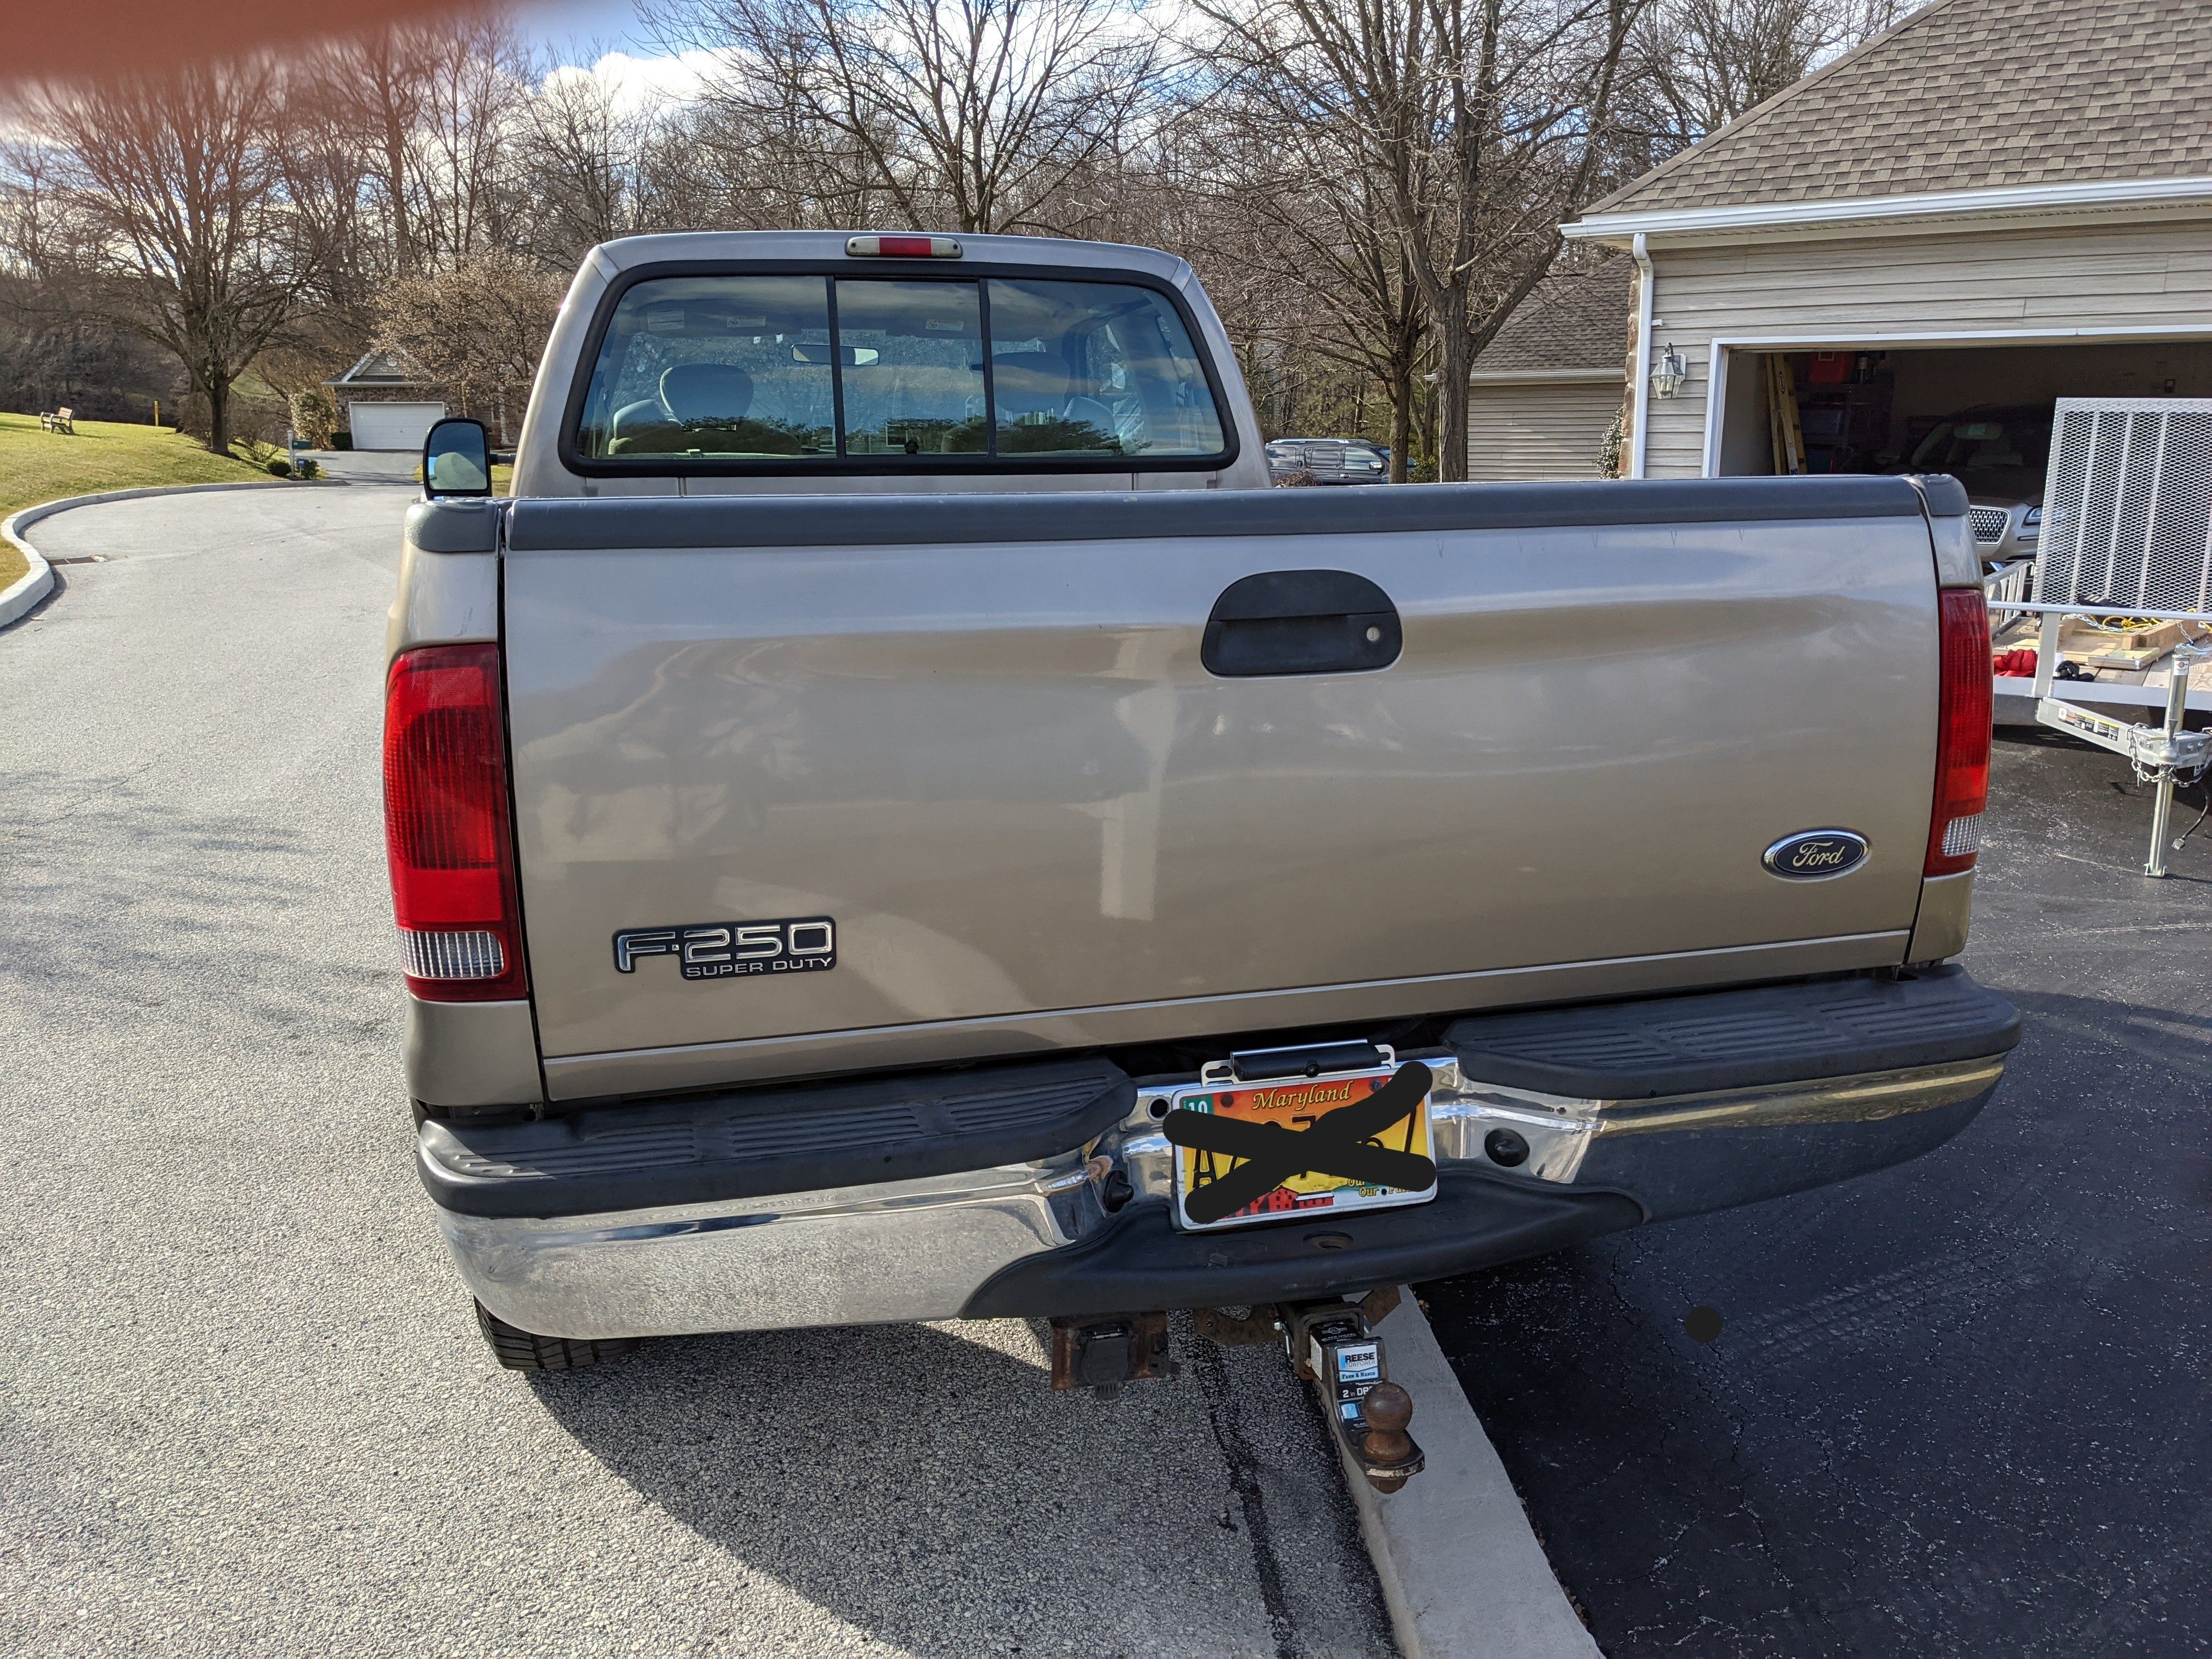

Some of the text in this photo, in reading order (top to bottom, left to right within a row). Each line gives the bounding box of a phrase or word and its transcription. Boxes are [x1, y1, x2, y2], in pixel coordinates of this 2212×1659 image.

[1792, 842, 1846, 867] Ford
[686, 957, 833, 977] SUPER DUTY
[1252, 1080, 1353, 1111] Maryland
[1359, 1187, 1379, 1197] Our
[1345, 1352, 1375, 1363] REESE
[1342, 1390, 1349, 1398] 2
